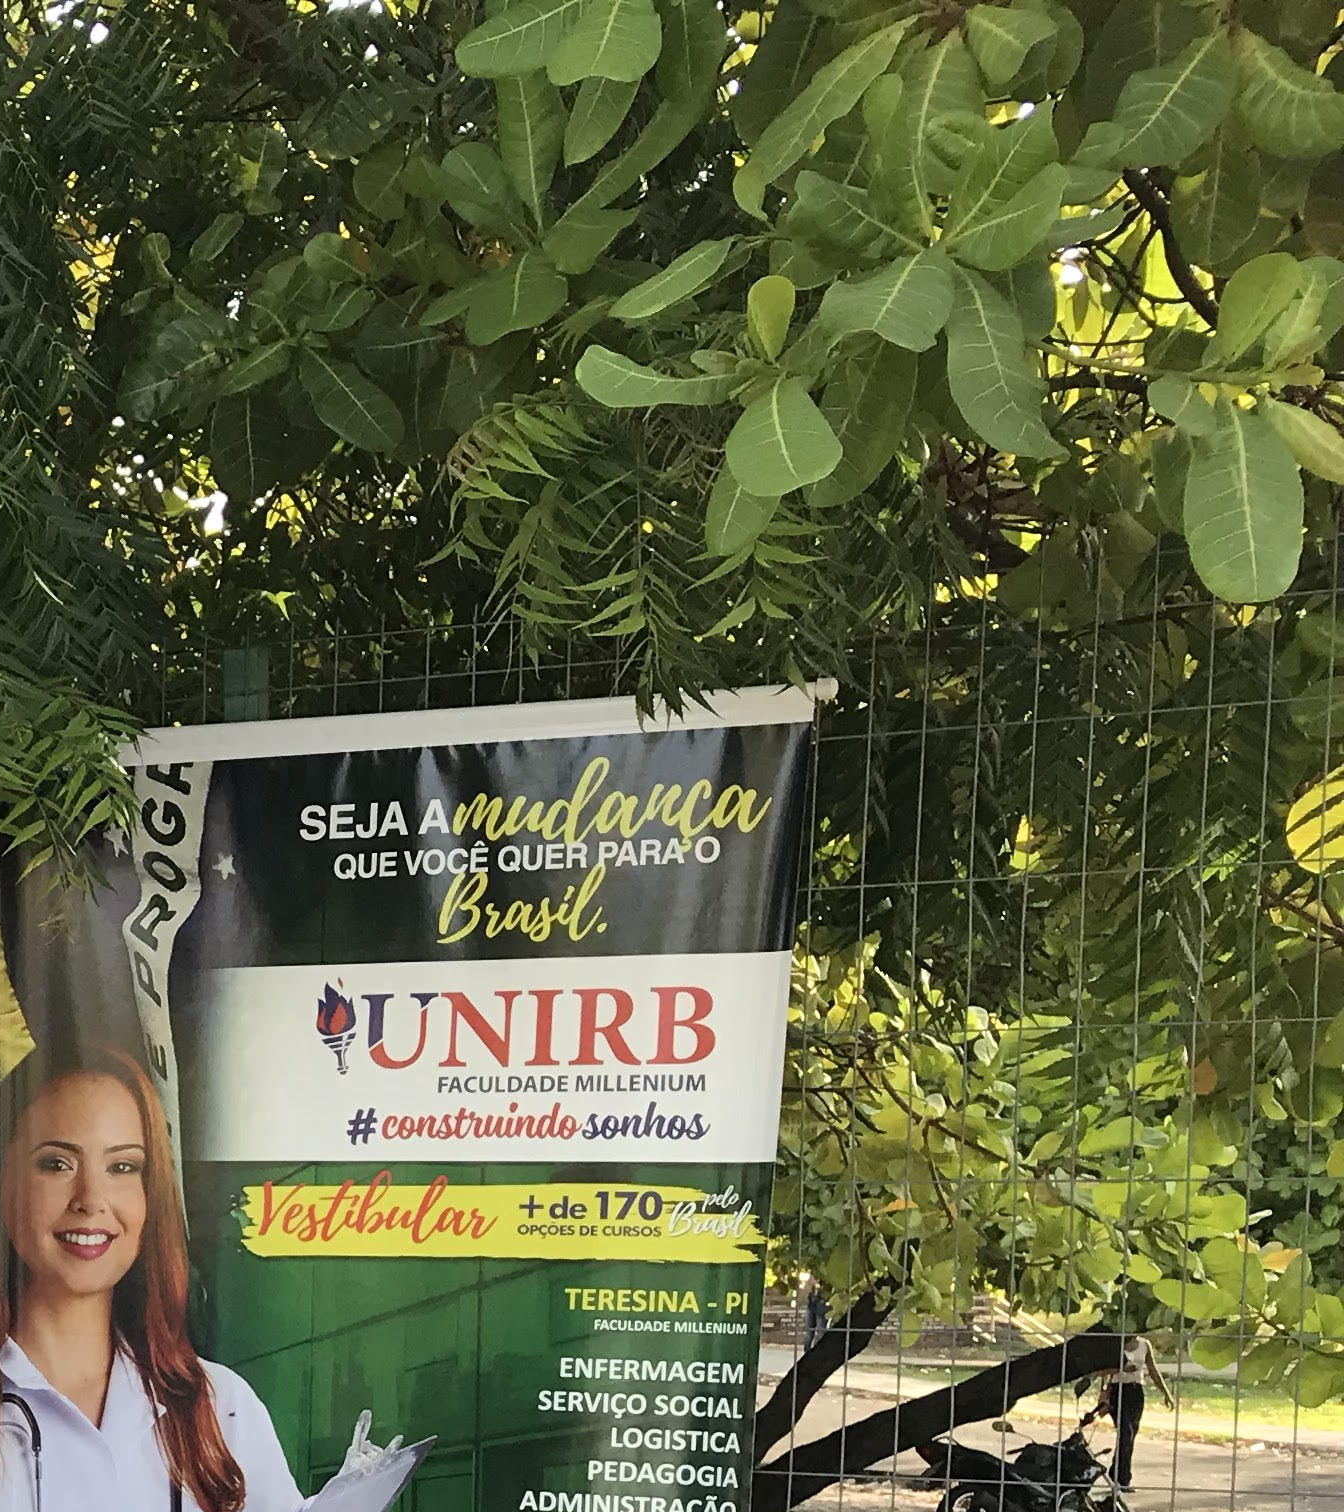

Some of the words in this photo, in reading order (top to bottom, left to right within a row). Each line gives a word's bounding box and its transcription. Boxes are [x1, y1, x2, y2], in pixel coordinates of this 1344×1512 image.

[299, 801, 408, 841] SEJA
[418, 798, 450, 835] A
[453, 756, 773, 852] mudança
[334, 849, 397, 880] QUE
[404, 841, 489, 877] VOCÊ
[497, 842, 588, 873] QUER
[599, 839, 684, 868] PARA
[694, 836, 721, 864] O
[437, 863, 610, 944] Brasil.
[359, 986, 717, 1069] UNIRB
[437, 1076, 568, 1094] FACULDADE
[575, 1074, 707, 1093] MILLENIUM
[257, 1169, 498, 1244] Vestibular
[595, 1191, 663, 1220] 170
[702, 1184, 740, 1213] pelo
[517, 1222, 575, 1239] OPÇÕES
[579, 1225, 598, 1236] DE
[602, 1225, 662, 1237] CURSOS
[668, 1200, 753, 1238] Brasil
[564, 1288, 699, 1314] TERESINA
[726, 1292, 748, 1315] PI
[594, 1319, 671, 1333] FACULDADE
[674, 1320, 748, 1335] MILLENIUM
[560, 1357, 744, 1385] ENFERMAGEM
[538, 1390, 647, 1419] SERVIÇO
[654, 1395, 743, 1420] SOCIAL
[610, 1427, 740, 1454] LOGISTICA
[587, 1460, 738, 1489] PEDAGOGIA
